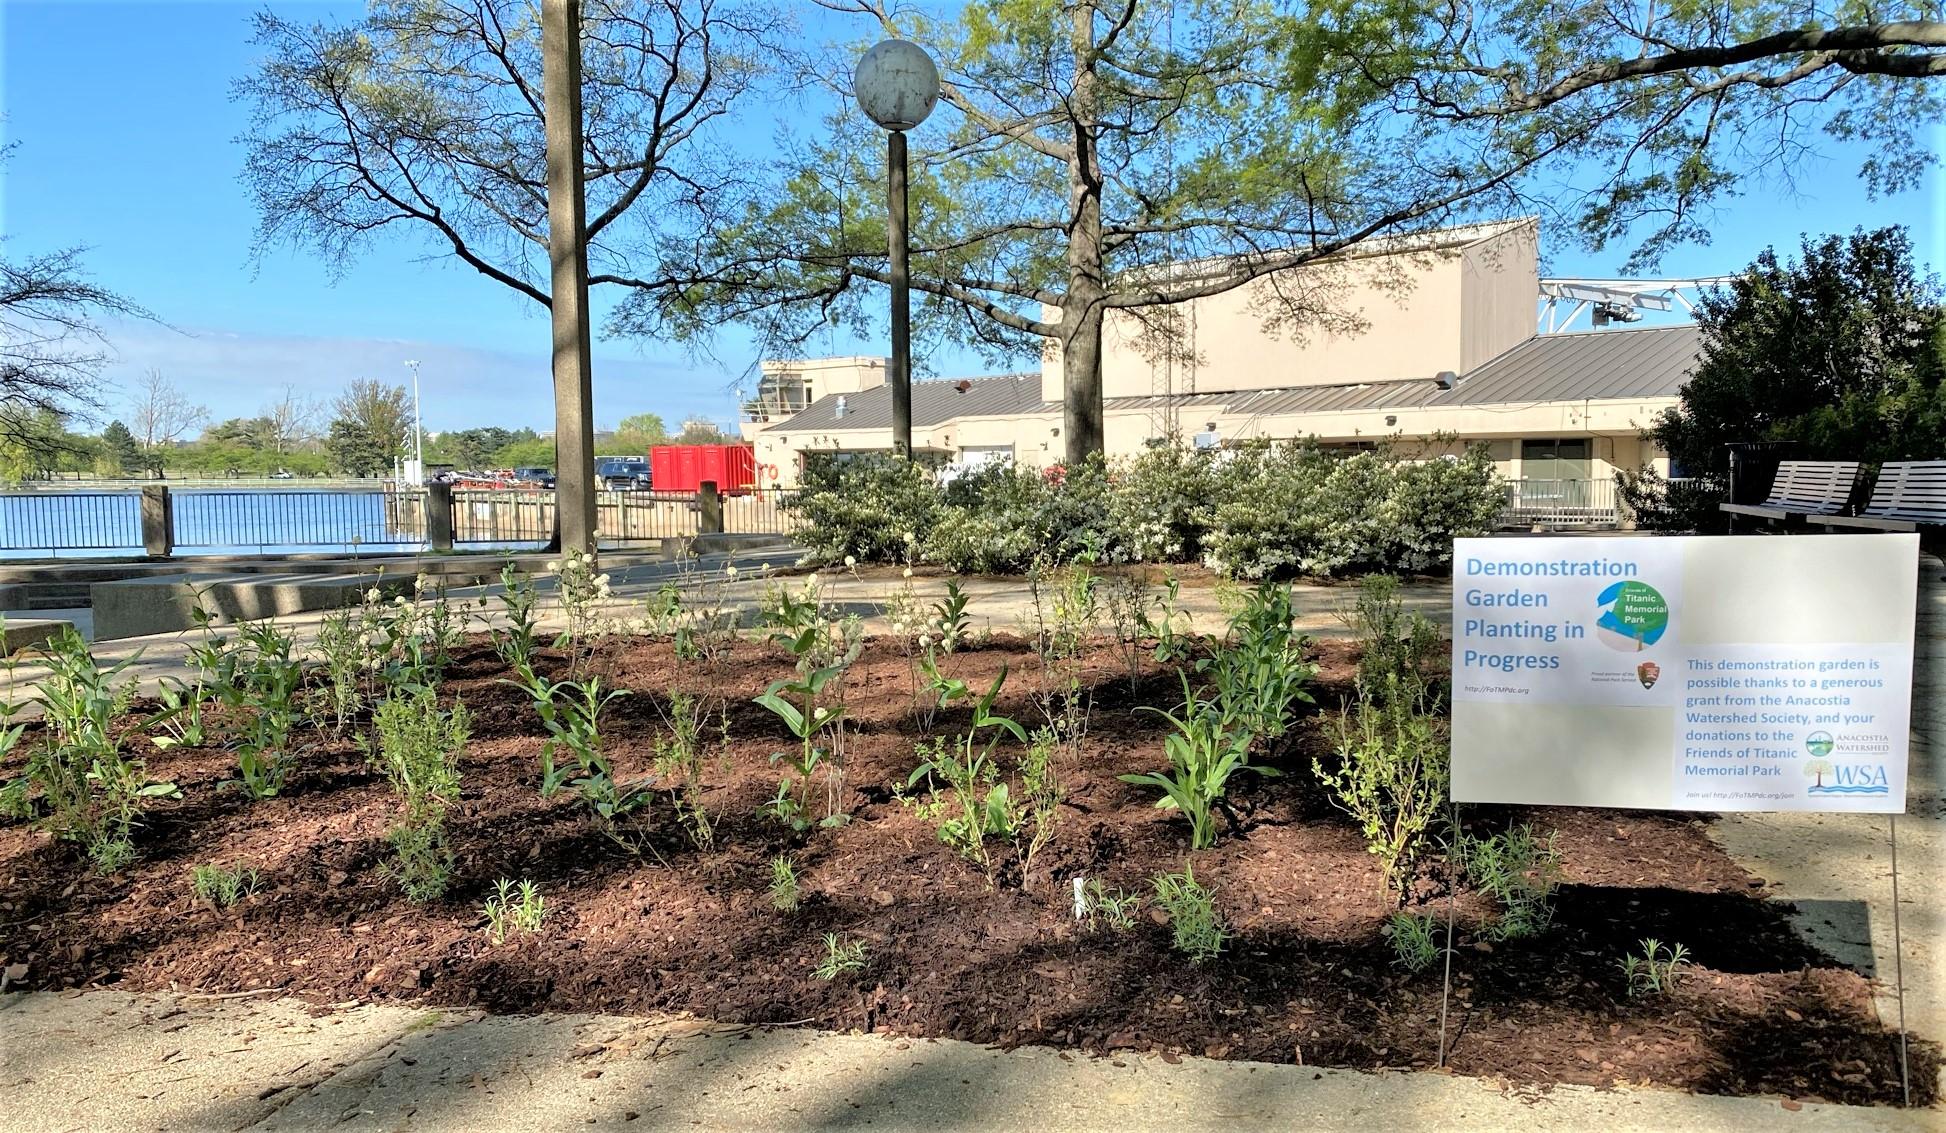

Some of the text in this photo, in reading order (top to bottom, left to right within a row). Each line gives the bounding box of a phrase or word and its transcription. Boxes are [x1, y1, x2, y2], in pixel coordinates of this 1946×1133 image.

[1467, 558, 1637, 576] Demonstration
[1466, 589, 1548, 607] Garden
[1465, 620, 1584, 642] Planting in
[1465, 650, 1559, 672] Progress
[1688, 659, 1879, 672] This demonstration garden is
[1687, 678, 1883, 690] possible thanks to a generous
[1686, 695, 1850, 708] grant from the Anacostia
[1687, 713, 1874, 725] Watershed Society, and your
[1686, 730, 1794, 741] donations to the
[1686, 748, 1797, 758] Friends of Titanic
[1685, 766, 1781, 776] Memorial Park
[1835, 766, 1888, 785] WSA
